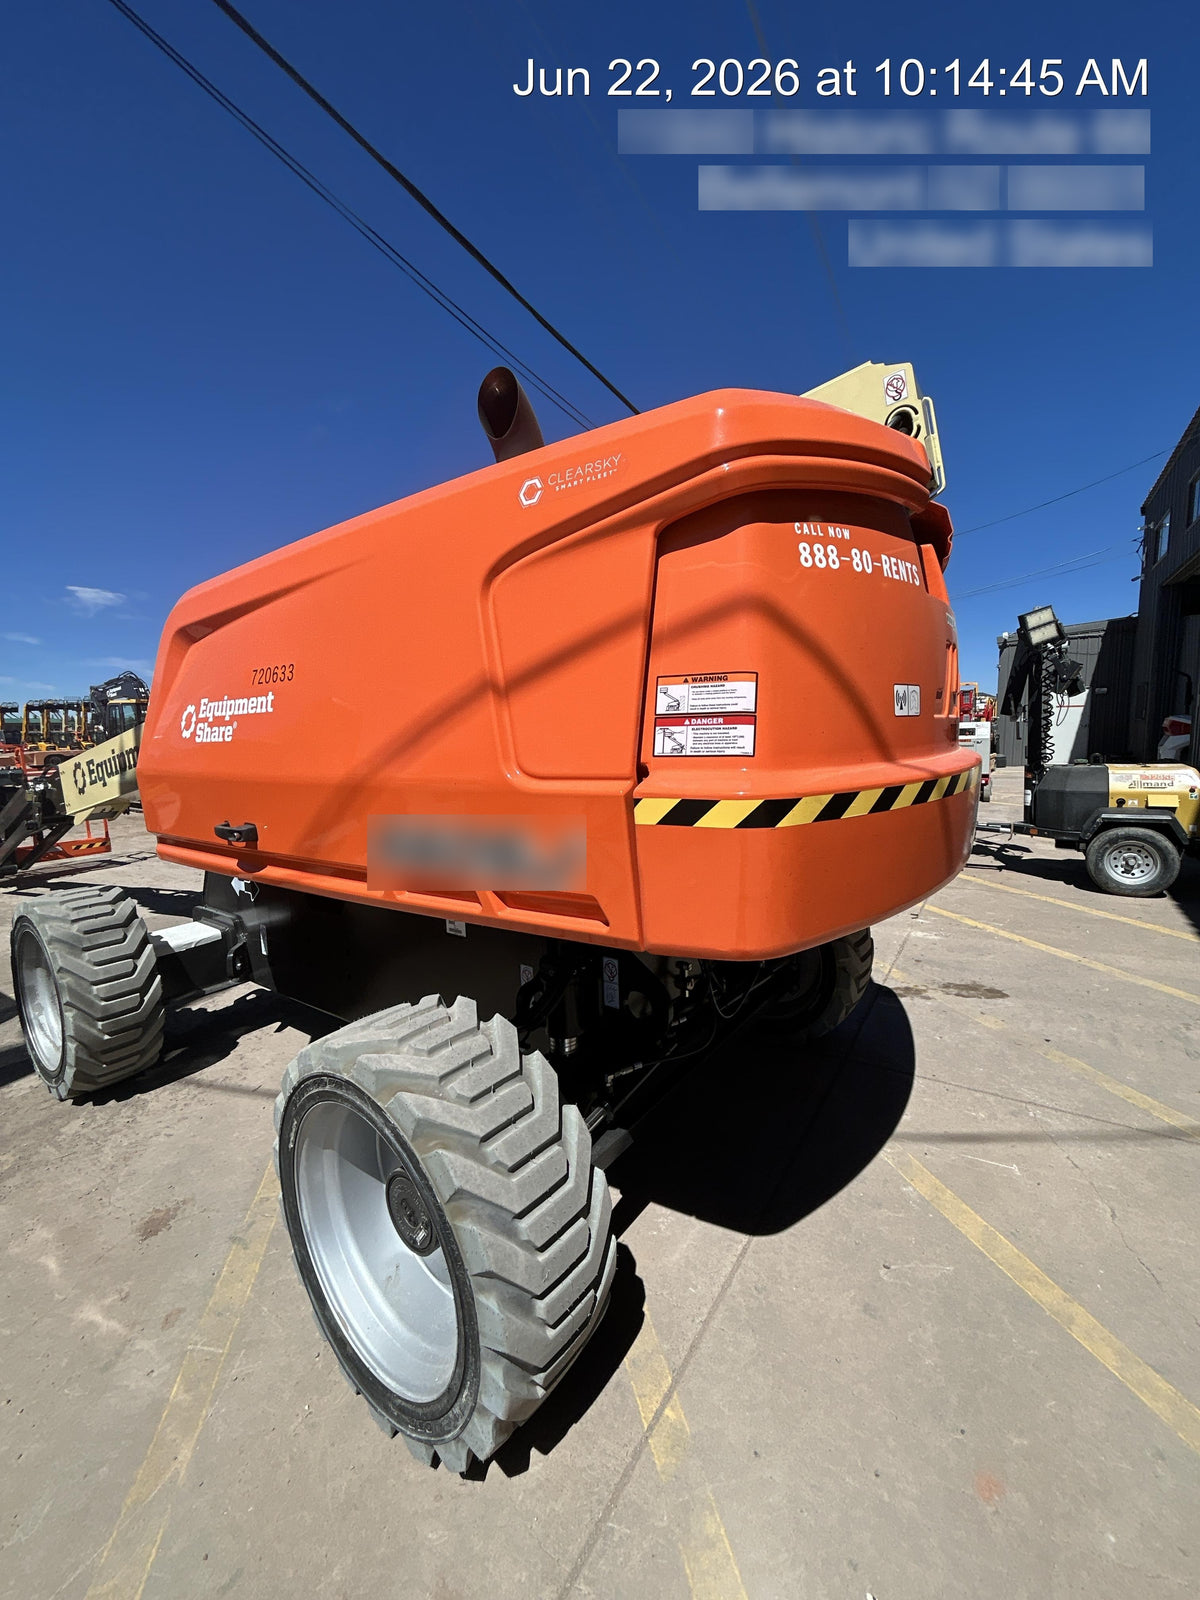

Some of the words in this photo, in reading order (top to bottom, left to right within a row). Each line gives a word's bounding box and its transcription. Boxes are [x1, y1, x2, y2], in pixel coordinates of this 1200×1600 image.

[547, 453, 622, 486] CLEARSKY
[555, 478, 584, 492] SMART
[794, 522, 824, 537] CALL
[827, 525, 850, 540] NOW
[798, 541, 920, 586] 888-80-RENTS
[251, 663, 295, 686] 720633
[691, 675, 728, 683] WARNING
[198, 691, 275, 722] Equipment
[691, 717, 724, 725] DANGER
